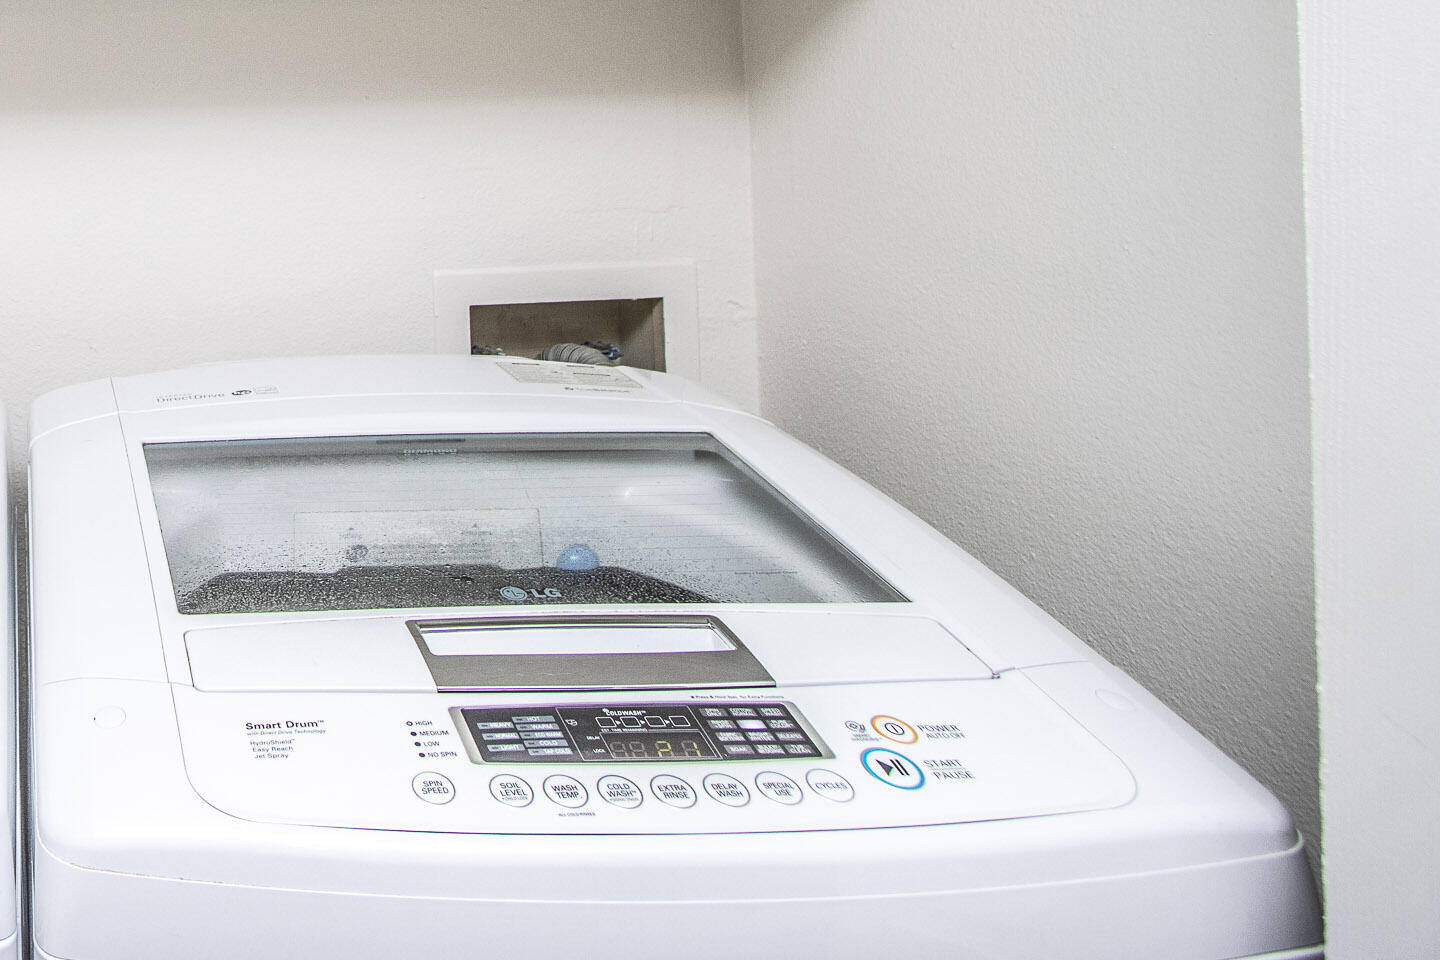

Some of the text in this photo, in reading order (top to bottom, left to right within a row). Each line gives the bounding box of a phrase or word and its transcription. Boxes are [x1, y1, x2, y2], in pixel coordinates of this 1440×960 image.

[532, 587, 561, 598] LG
[245, 721, 318, 730] Smart Drum
[916, 724, 961, 732] POWER
[923, 759, 963, 767] START
[933, 771, 976, 780] PAUSE
[657, 784, 687, 792] EXTRA
[814, 782, 848, 790] CYCLES
[500, 789, 528, 797] LEVEL
[556, 791, 582, 799] TEMP.
[607, 790, 633, 798] WASH
[663, 791, 690, 799] RINSE
[715, 790, 743, 798] WASH
[774, 789, 792, 797] USE
